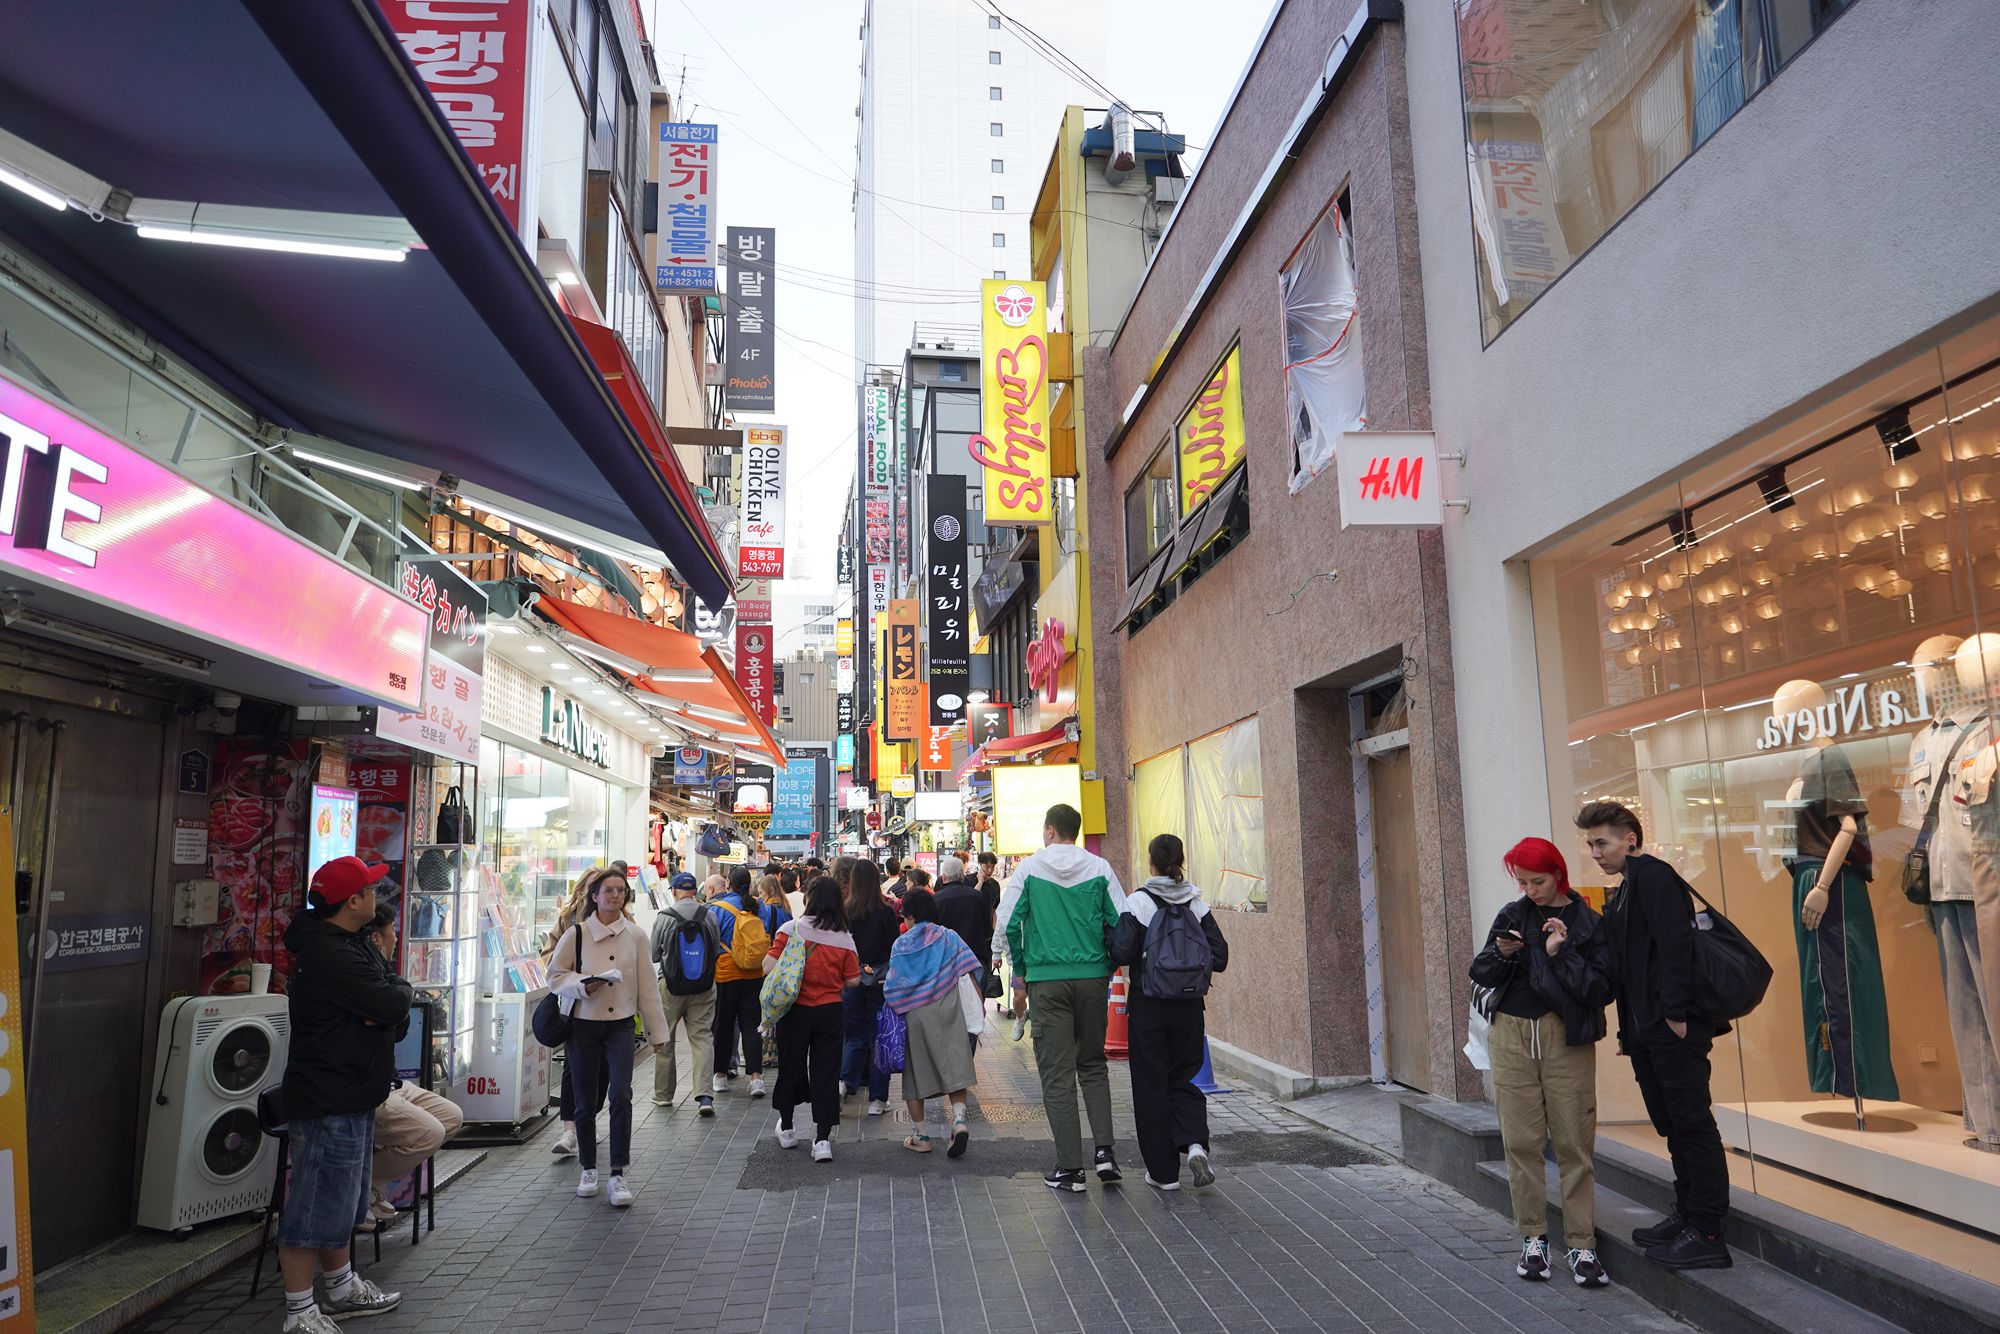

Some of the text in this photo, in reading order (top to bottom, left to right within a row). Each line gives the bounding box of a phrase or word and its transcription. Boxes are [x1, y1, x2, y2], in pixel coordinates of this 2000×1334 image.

[664, 126, 715, 140] 서울전기
[658, 277, 713, 287] 011-822-1108
[741, 348, 761, 361] 4F
[867, 388, 875, 440] GURKHA
[968, 335, 1047, 512] Emily's
[876, 388, 887, 484] HALAL FOOD
[764, 447, 781, 500] OLIVE
[1360, 456, 1423, 501] H&M
[747, 446, 764, 522] CHICKEN
[747, 521, 774, 537] cafe
[748, 550, 775, 560] 명동점
[742, 562, 782, 573] 543-7677
[749, 602, 770, 610] Body
[895, 627, 914, 680] レモン
[420, 724, 447, 745] 전문점
[467, 736, 478, 754] 2F
[190, 772, 197, 788] 5
[60, 926, 144, 949] 한국전력공사
